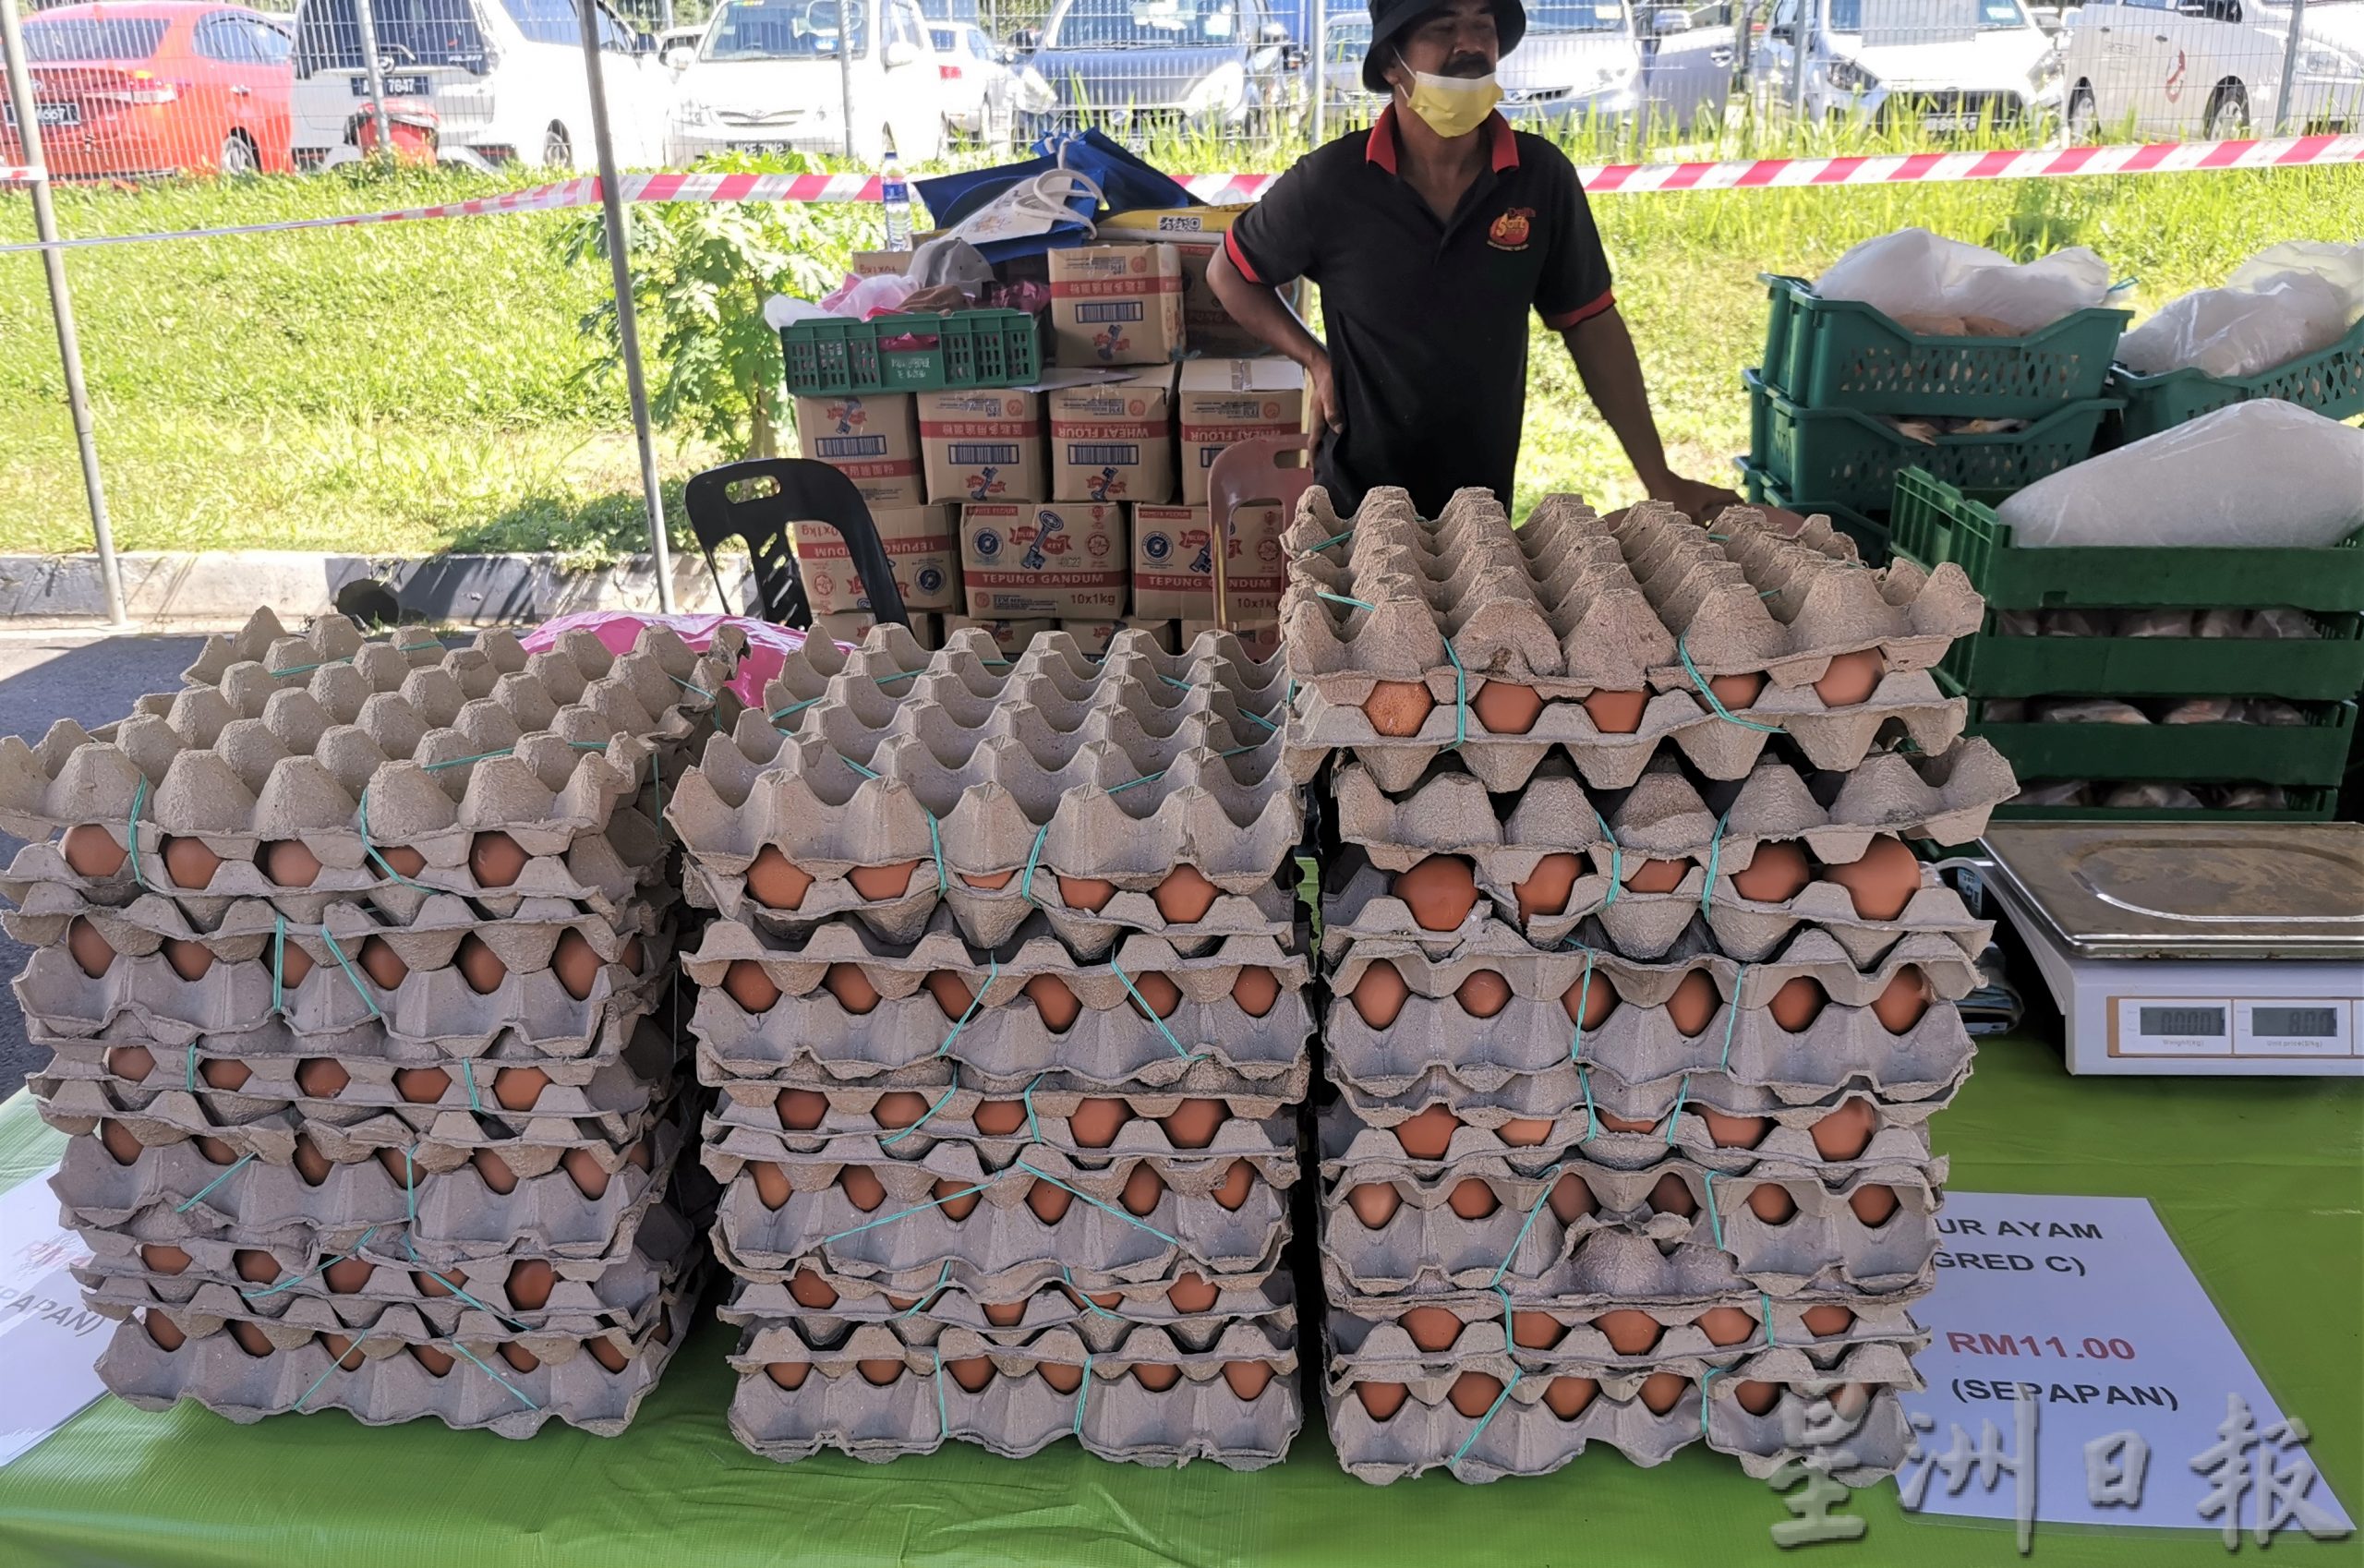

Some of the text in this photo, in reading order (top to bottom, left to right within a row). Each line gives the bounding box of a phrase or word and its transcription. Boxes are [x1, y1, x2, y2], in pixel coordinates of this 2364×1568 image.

[1058, 428, 1149, 439] WHEAT FLOUR
[982, 573, 1104, 584] TEPUNG GANDUM
[1149, 576, 1201, 587] TEPUNG
[1070, 593, 1116, 606] 10x1kg
[1997, 1221, 2104, 1239] AYAM
[2044, 1256, 2086, 1276] C)
[1946, 1332, 2136, 1360] RM11.00
[1951, 1379, 2178, 1411] (SEPAPAN)
